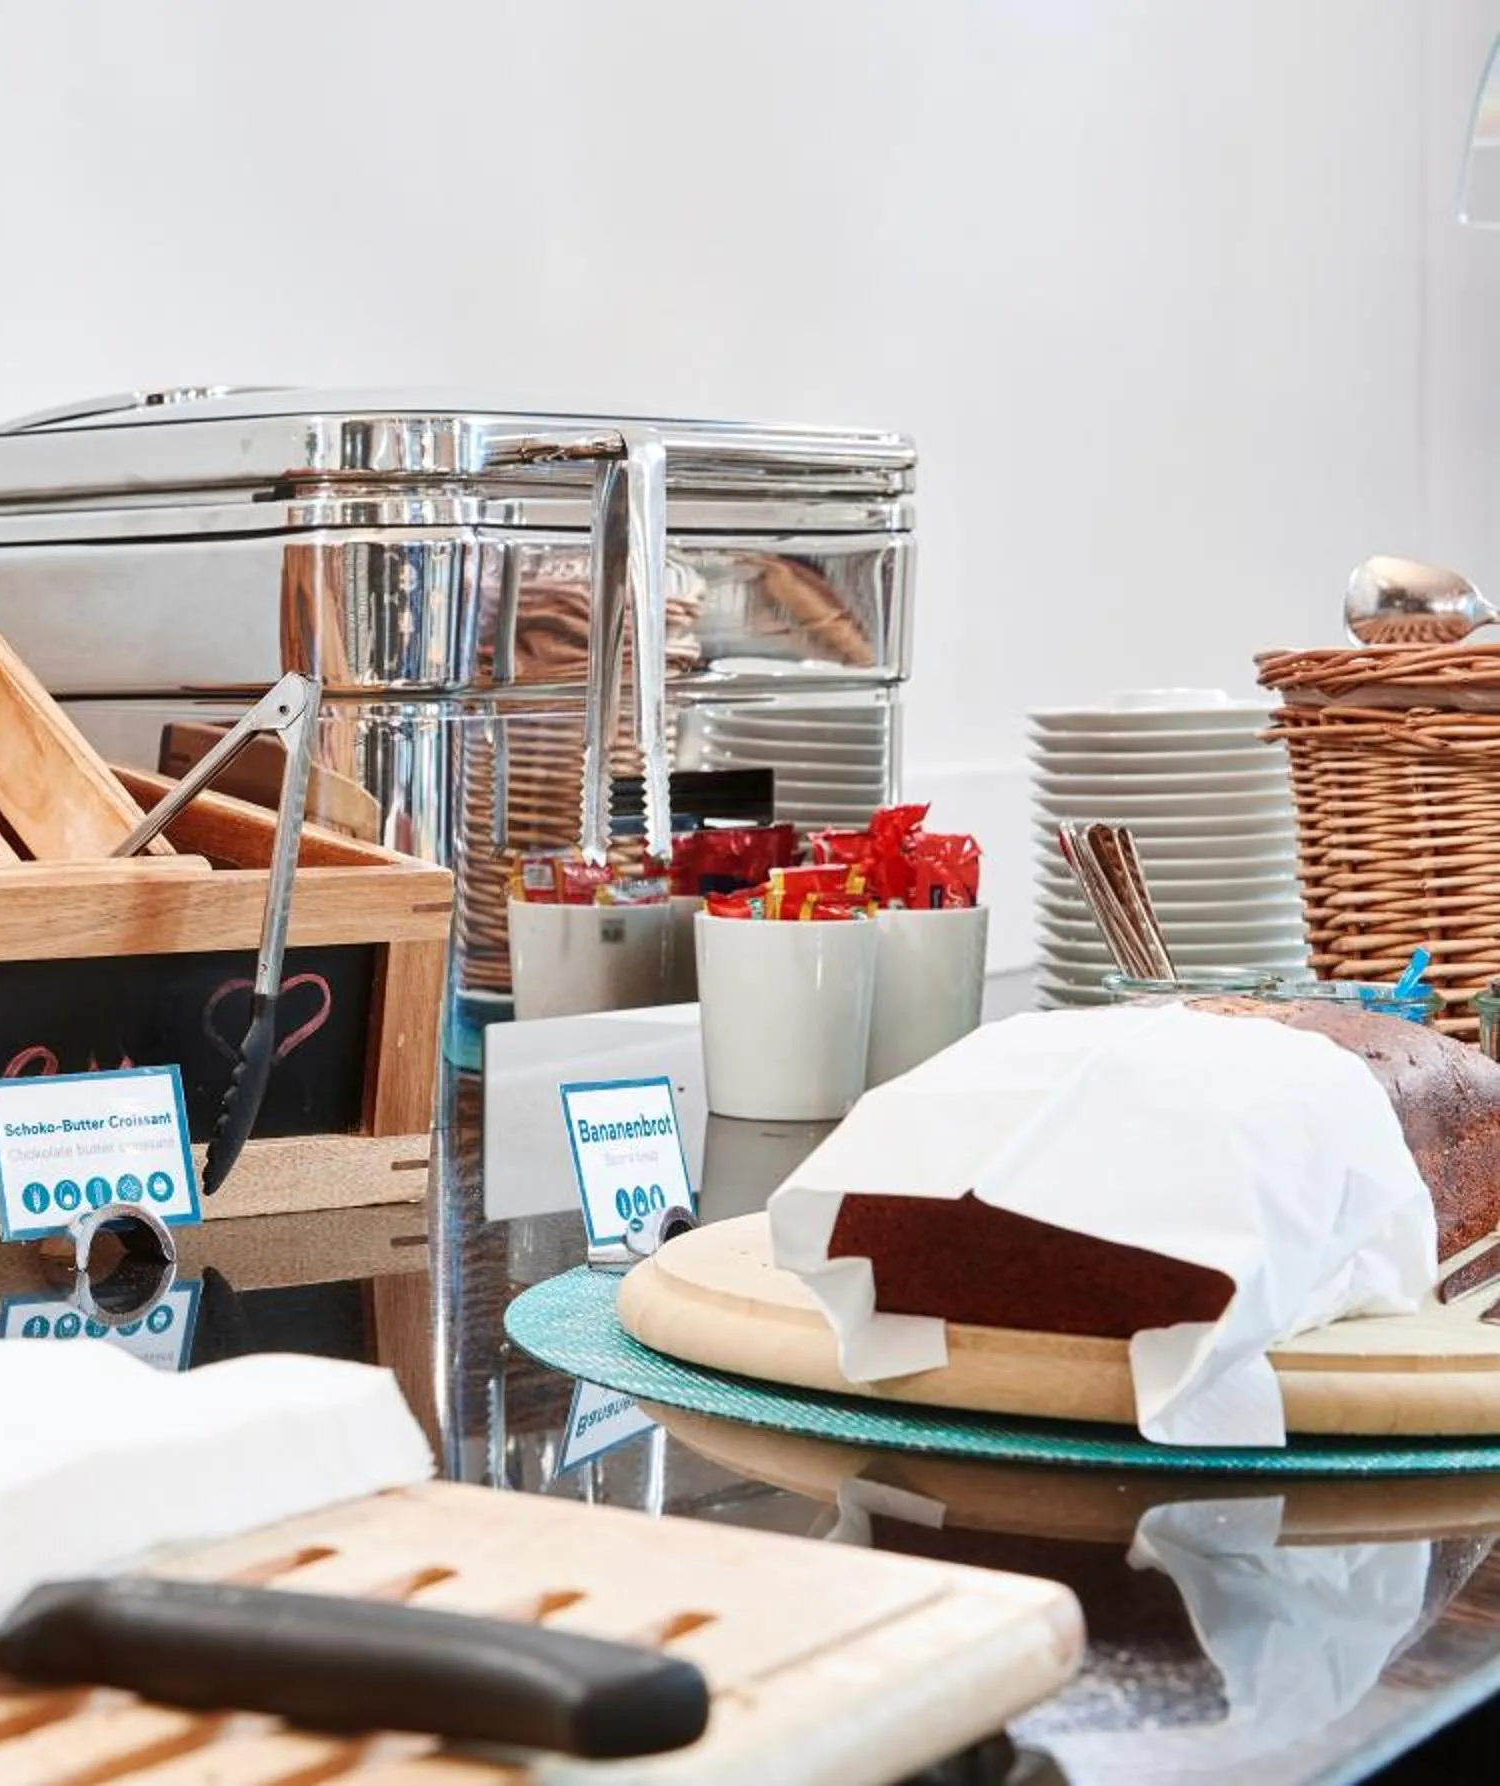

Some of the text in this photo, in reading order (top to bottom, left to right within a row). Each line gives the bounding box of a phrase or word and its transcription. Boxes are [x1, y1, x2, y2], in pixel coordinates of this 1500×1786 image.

[4, 1112, 172, 1137] Schoko-Butter Croissant
[578, 1113, 673, 1143] Bananenbrot
